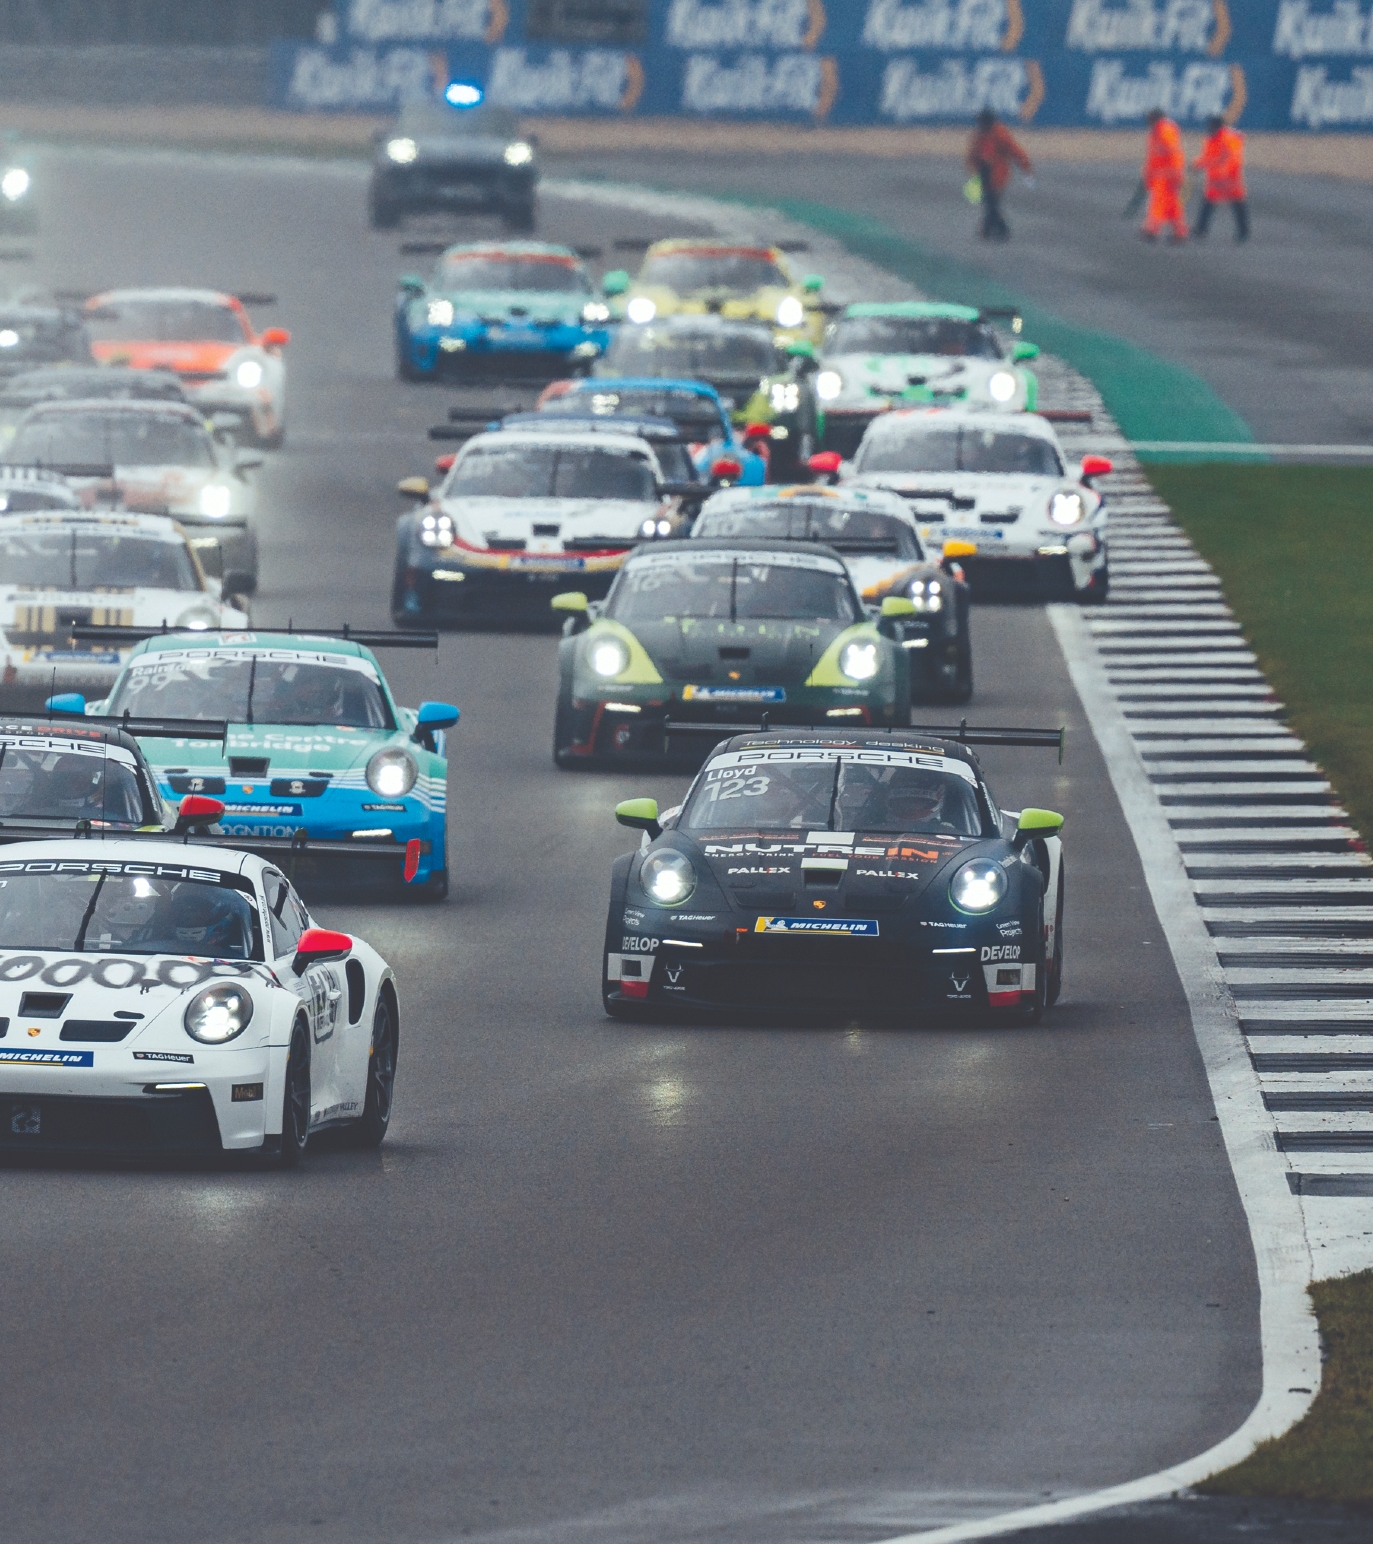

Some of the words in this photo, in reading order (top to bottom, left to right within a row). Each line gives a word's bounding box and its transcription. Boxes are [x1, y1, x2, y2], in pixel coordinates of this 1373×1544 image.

[159, 651, 348, 665] PORSCHE
[127, 673, 174, 694] 99
[171, 739, 331, 753] Tonbridge
[264, 733, 368, 746] Centre
[866, 740, 945, 753] desking
[738, 752, 944, 769] PORSCHE
[707, 765, 757, 782] Lloyd
[704, 776, 771, 802] 123
[225, 804, 294, 814] MICHELIN
[705, 843, 939, 859] NUTREIN
[728, 866, 791, 875] PALLEX
[856, 869, 919, 880] PALLEX
[790, 922, 868, 931] MICHELIN
[622, 936, 660, 951] DEVELOP
[980, 945, 1021, 961] DEVELOP
